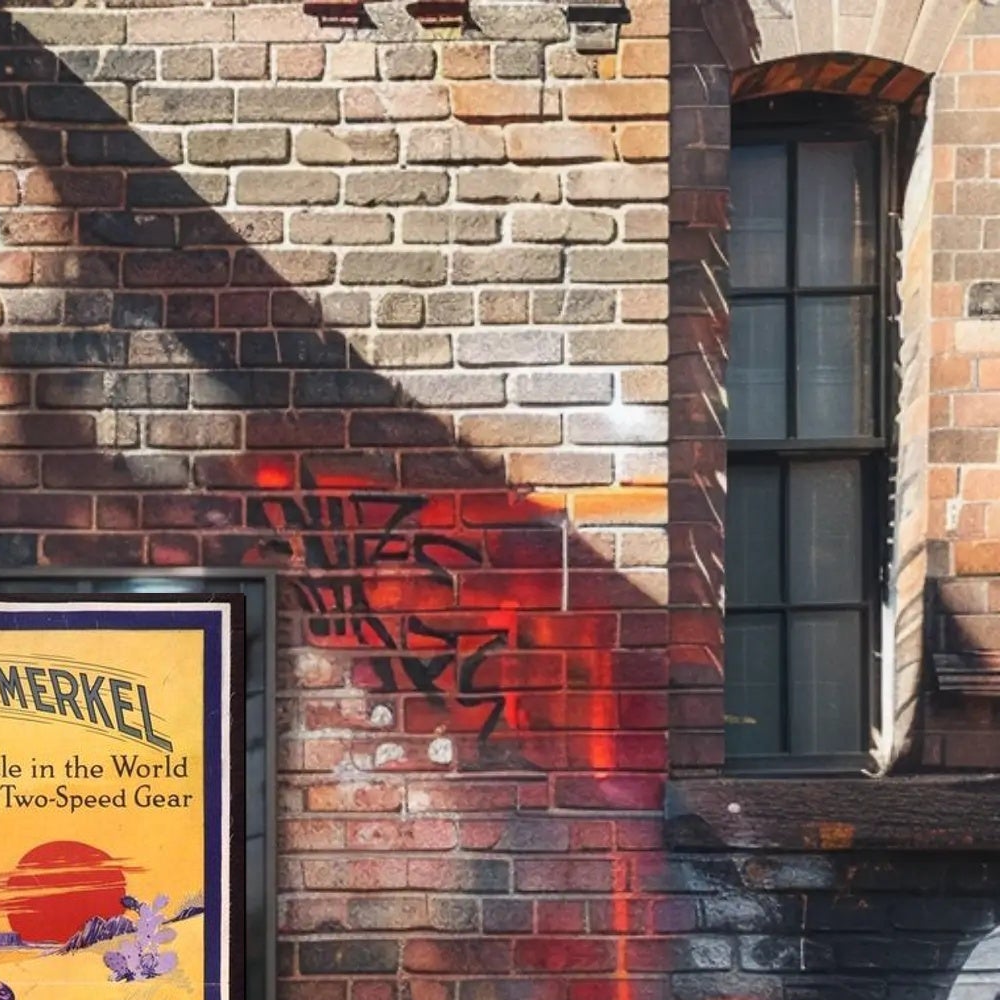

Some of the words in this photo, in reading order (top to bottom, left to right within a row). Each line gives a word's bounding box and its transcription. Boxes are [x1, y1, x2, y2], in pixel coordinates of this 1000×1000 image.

[31, 756, 55, 779] in
[64, 754, 103, 780] the
[111, 754, 188, 780] World
[0, 784, 126, 814] Two-Speed
[133, 784, 193, 808] Gear
